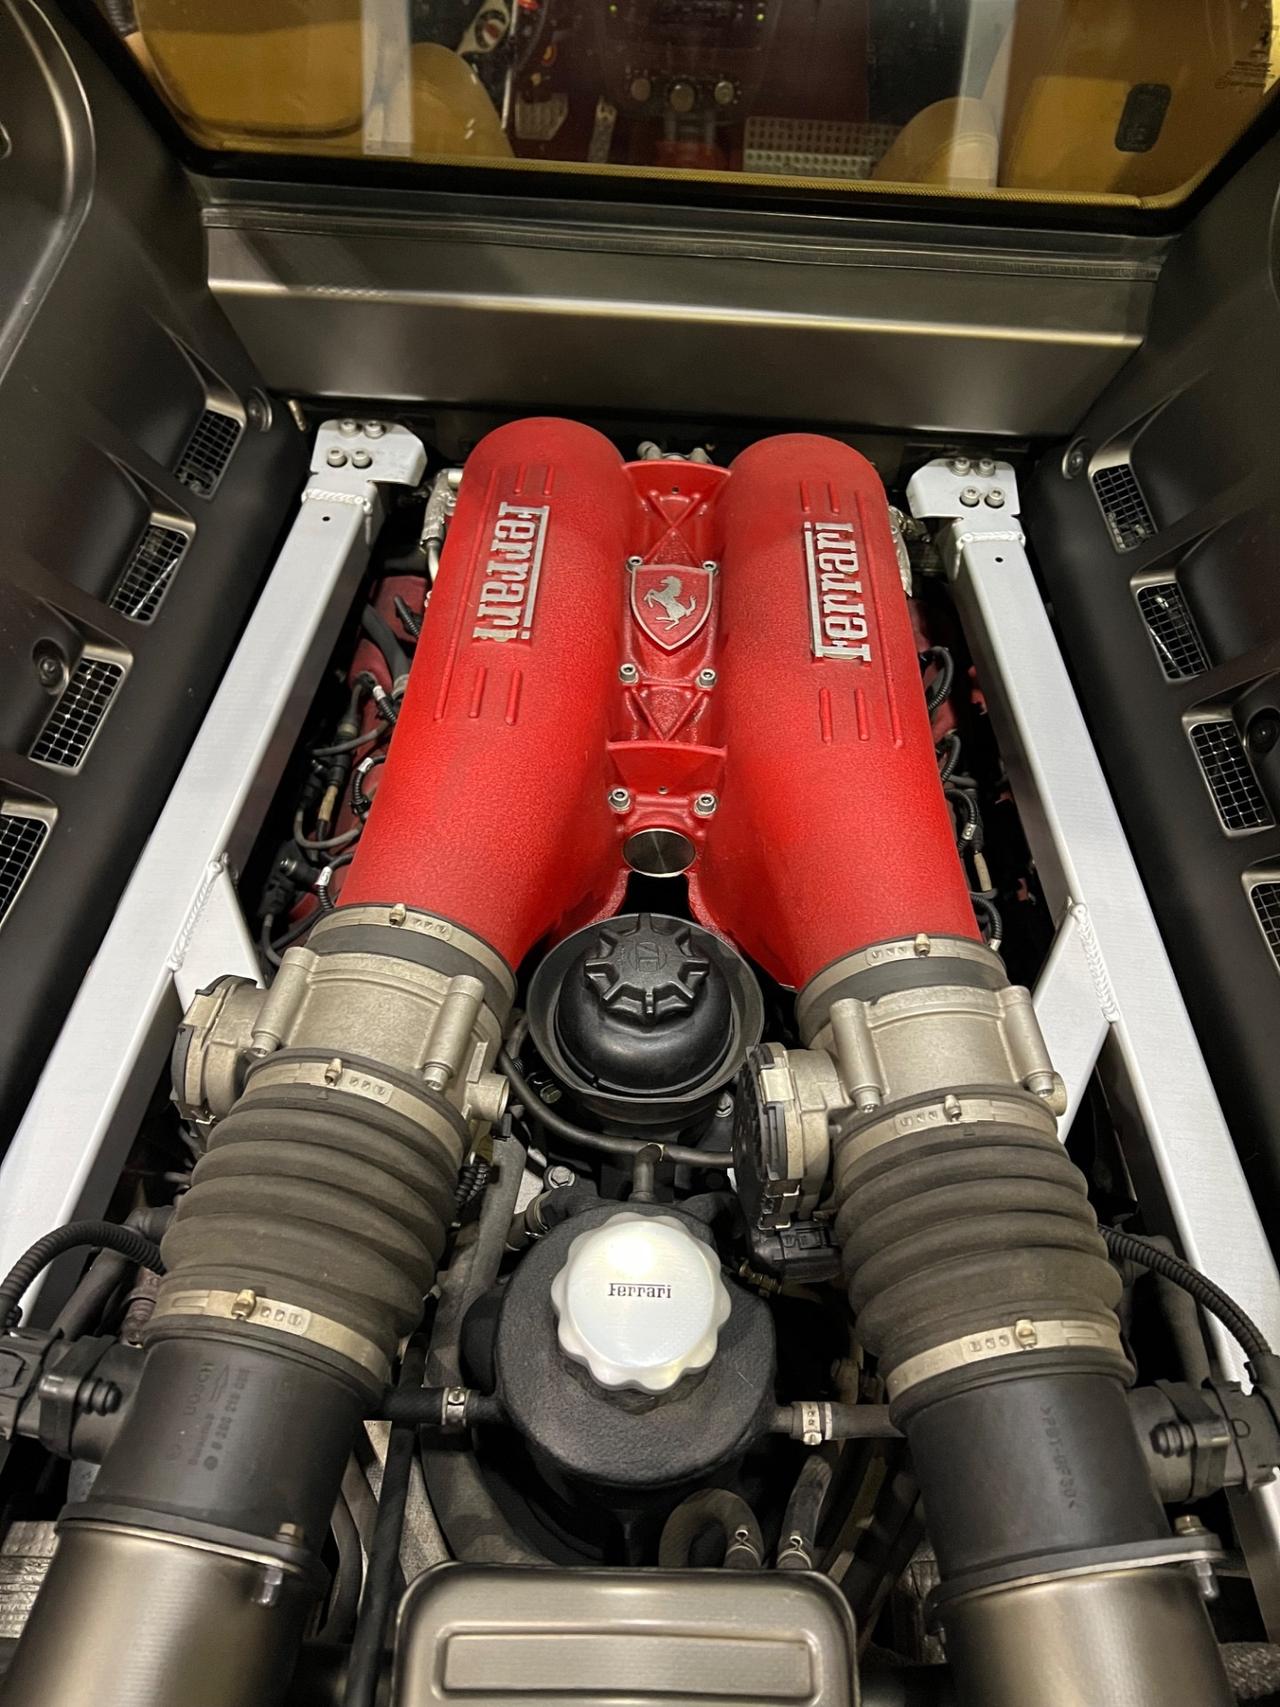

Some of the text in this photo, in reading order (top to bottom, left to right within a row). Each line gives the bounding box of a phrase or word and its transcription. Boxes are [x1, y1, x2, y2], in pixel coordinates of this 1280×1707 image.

[472, 501, 551, 643] Ferrari
[803, 521, 872, 661] Ferrari
[608, 1282, 672, 1299] Ferrari
